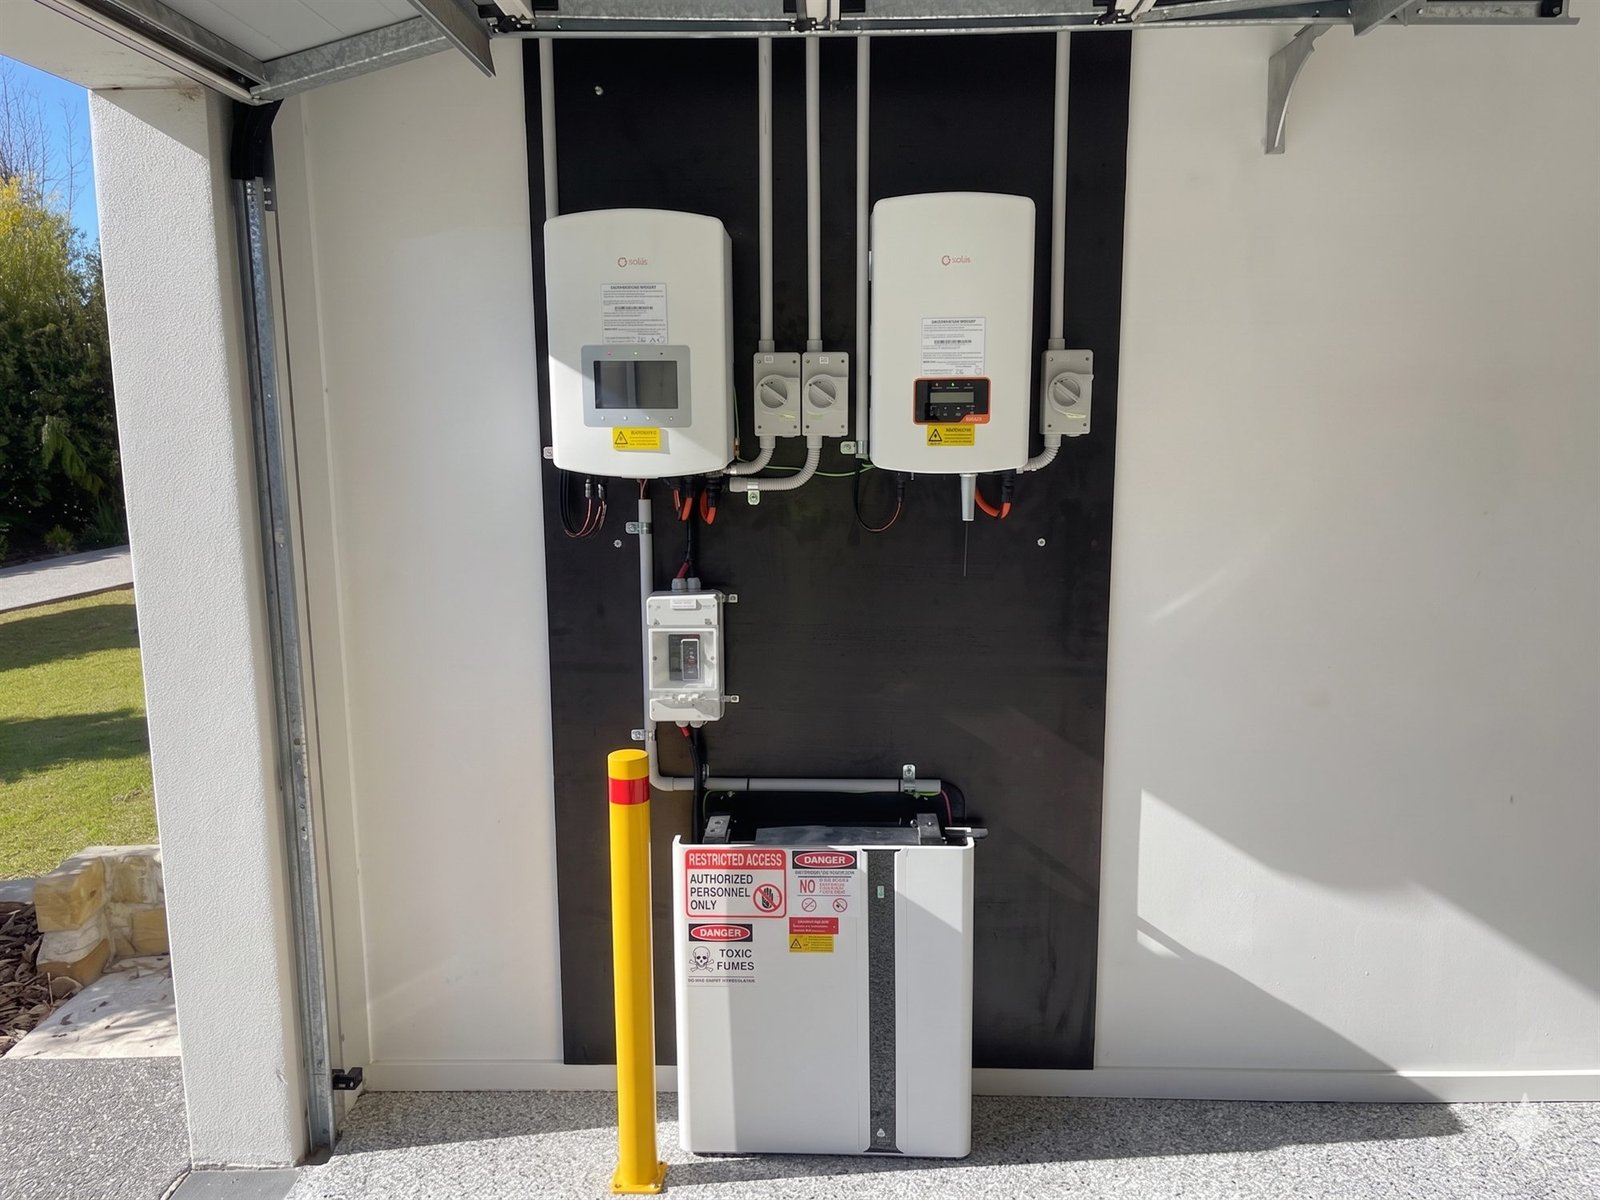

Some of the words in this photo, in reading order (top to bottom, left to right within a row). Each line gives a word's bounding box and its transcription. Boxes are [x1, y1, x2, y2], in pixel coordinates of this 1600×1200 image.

[688, 853, 744, 866] RESTRICTED
[746, 853, 782, 866] ACCESS
[804, 856, 846, 864] DANGER
[690, 874, 754, 885] AUTHORIZED
[799, 879, 816, 893] NO
[690, 887, 751, 897] PERSONNEL
[690, 900, 717, 910] ONLY
[700, 929, 742, 937] DANGER
[719, 948, 752, 958] TOXIC
[717, 961, 755, 971] FUMES
